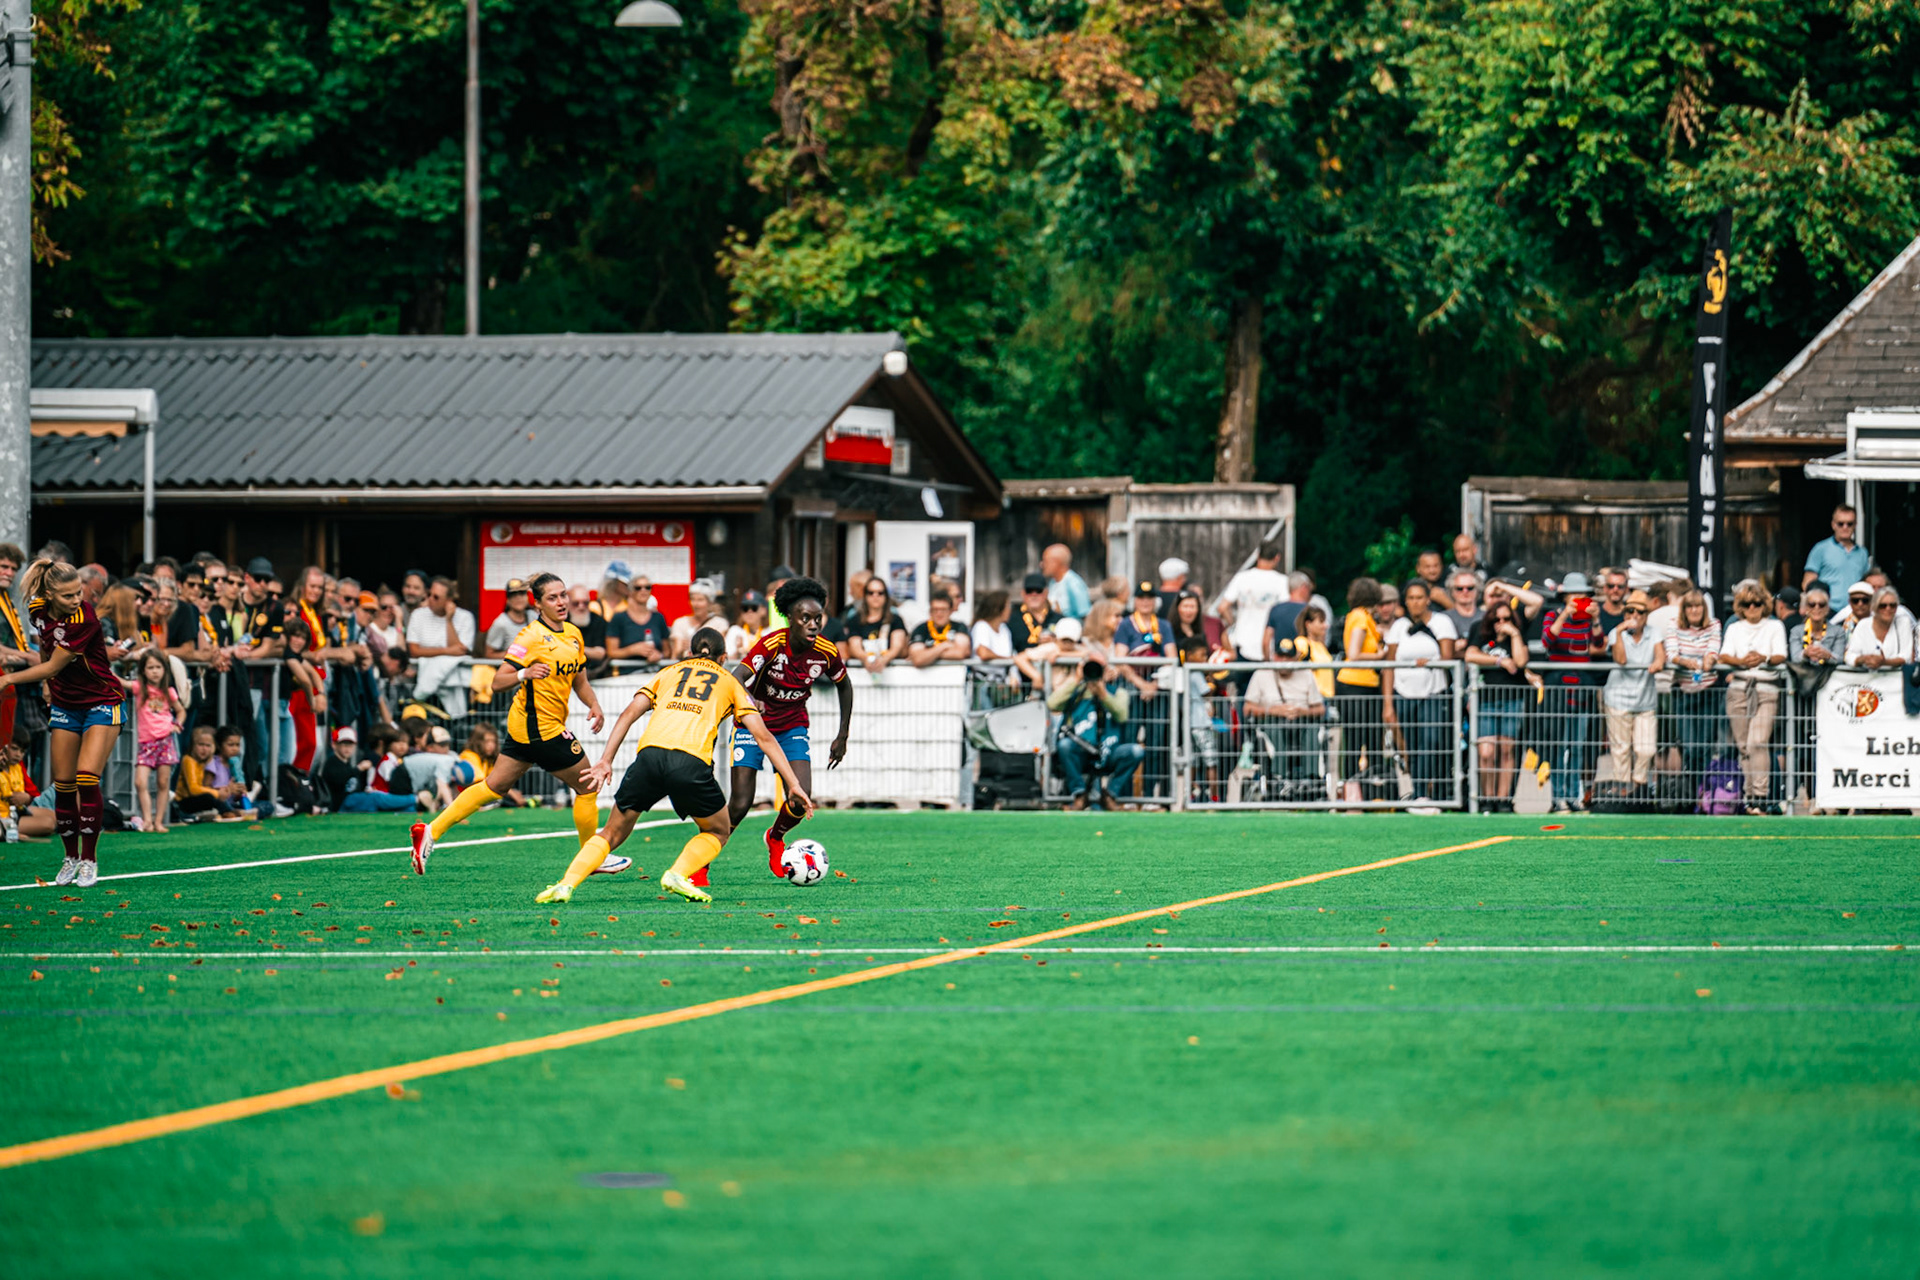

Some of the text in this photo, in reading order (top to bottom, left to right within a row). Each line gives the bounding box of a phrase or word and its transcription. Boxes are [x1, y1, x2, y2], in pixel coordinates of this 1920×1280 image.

[674, 667, 719, 702] 13
[666, 701, 703, 715] GRANGES
[1832, 768, 1911, 788] Merci
